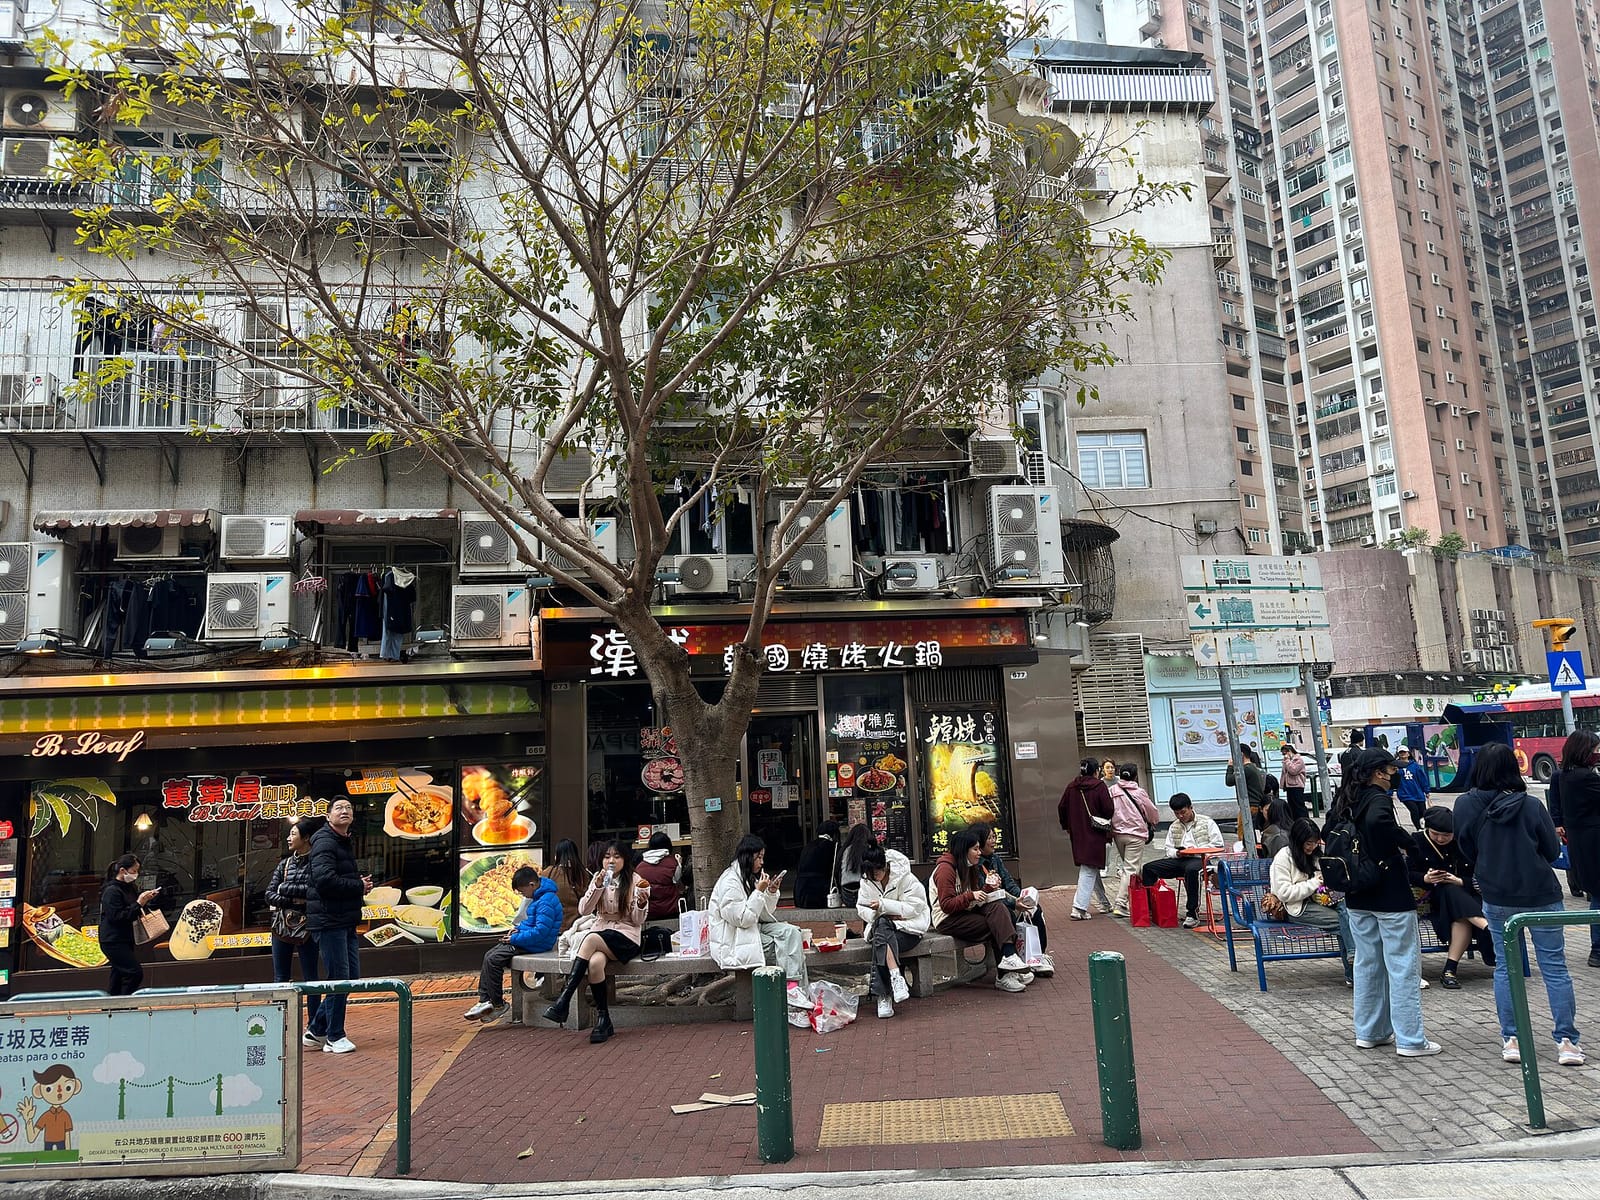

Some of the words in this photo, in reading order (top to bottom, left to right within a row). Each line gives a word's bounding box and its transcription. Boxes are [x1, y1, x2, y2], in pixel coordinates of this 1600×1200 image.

[32, 734, 69, 757] B.
[72, 730, 145, 762] Leaf
[1402, 768, 1414, 780] LA
[162, 776, 261, 808] 蕉葉屋
[26, 1053, 49, 1063] para
[61, 1050, 86, 1060] chão
[223, 1132, 243, 1142] 600
